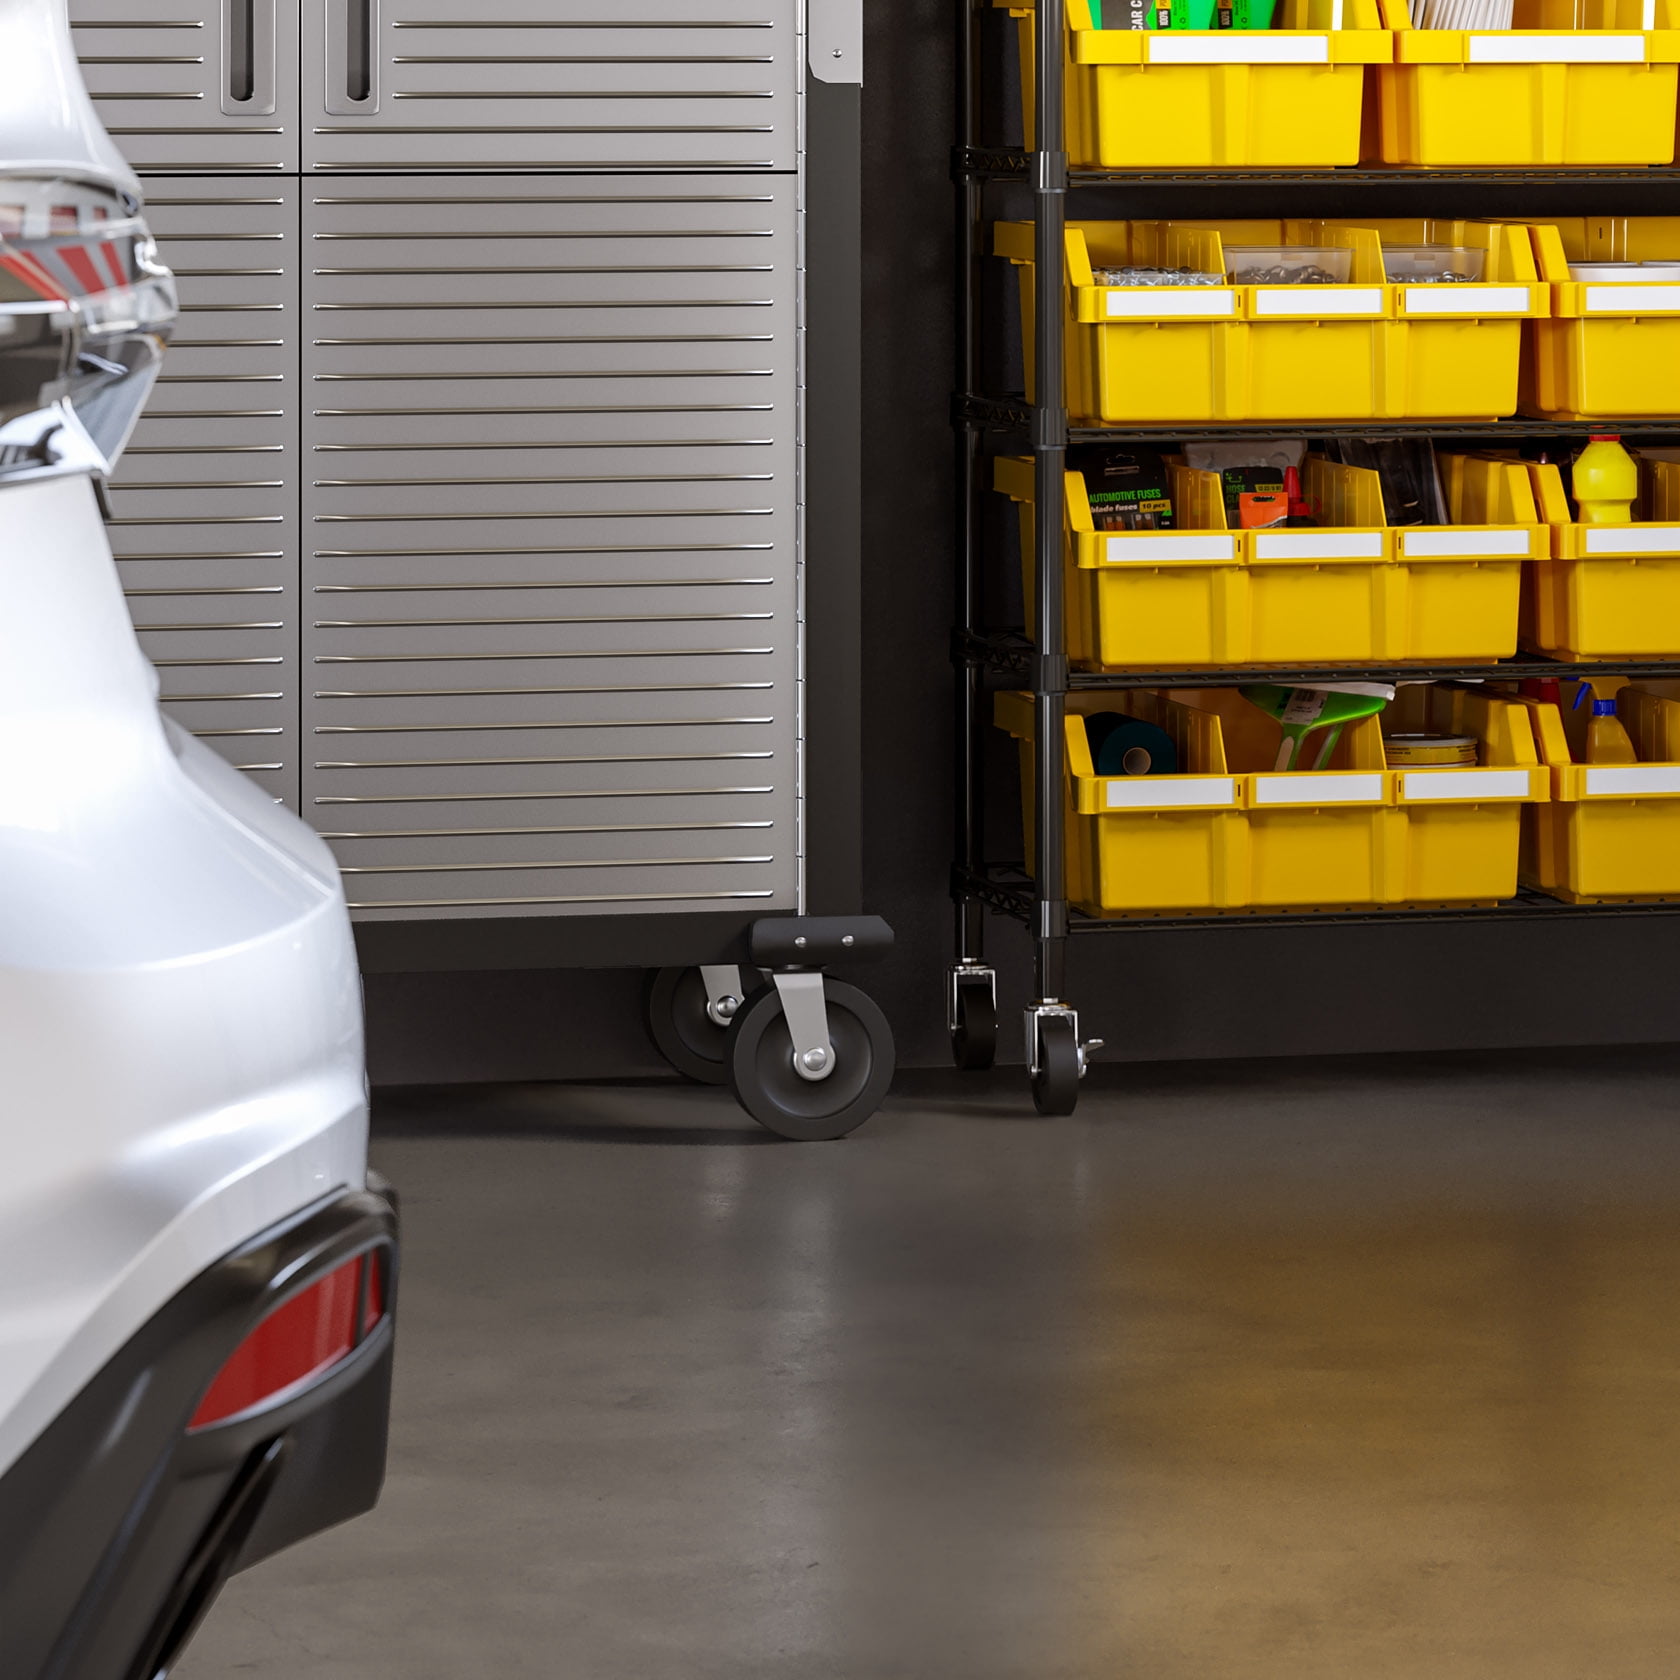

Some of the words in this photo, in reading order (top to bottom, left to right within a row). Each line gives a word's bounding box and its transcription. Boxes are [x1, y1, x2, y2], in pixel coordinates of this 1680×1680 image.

[1131, 11, 1144, 31] CAR
[1159, 10, 1169, 26] 100%
[1089, 489, 1137, 503] AUTOMOTIVE
[1137, 488, 1161, 499] FUSES
[1091, 504, 1113, 513] blade
[1115, 503, 1138, 512] fuses
